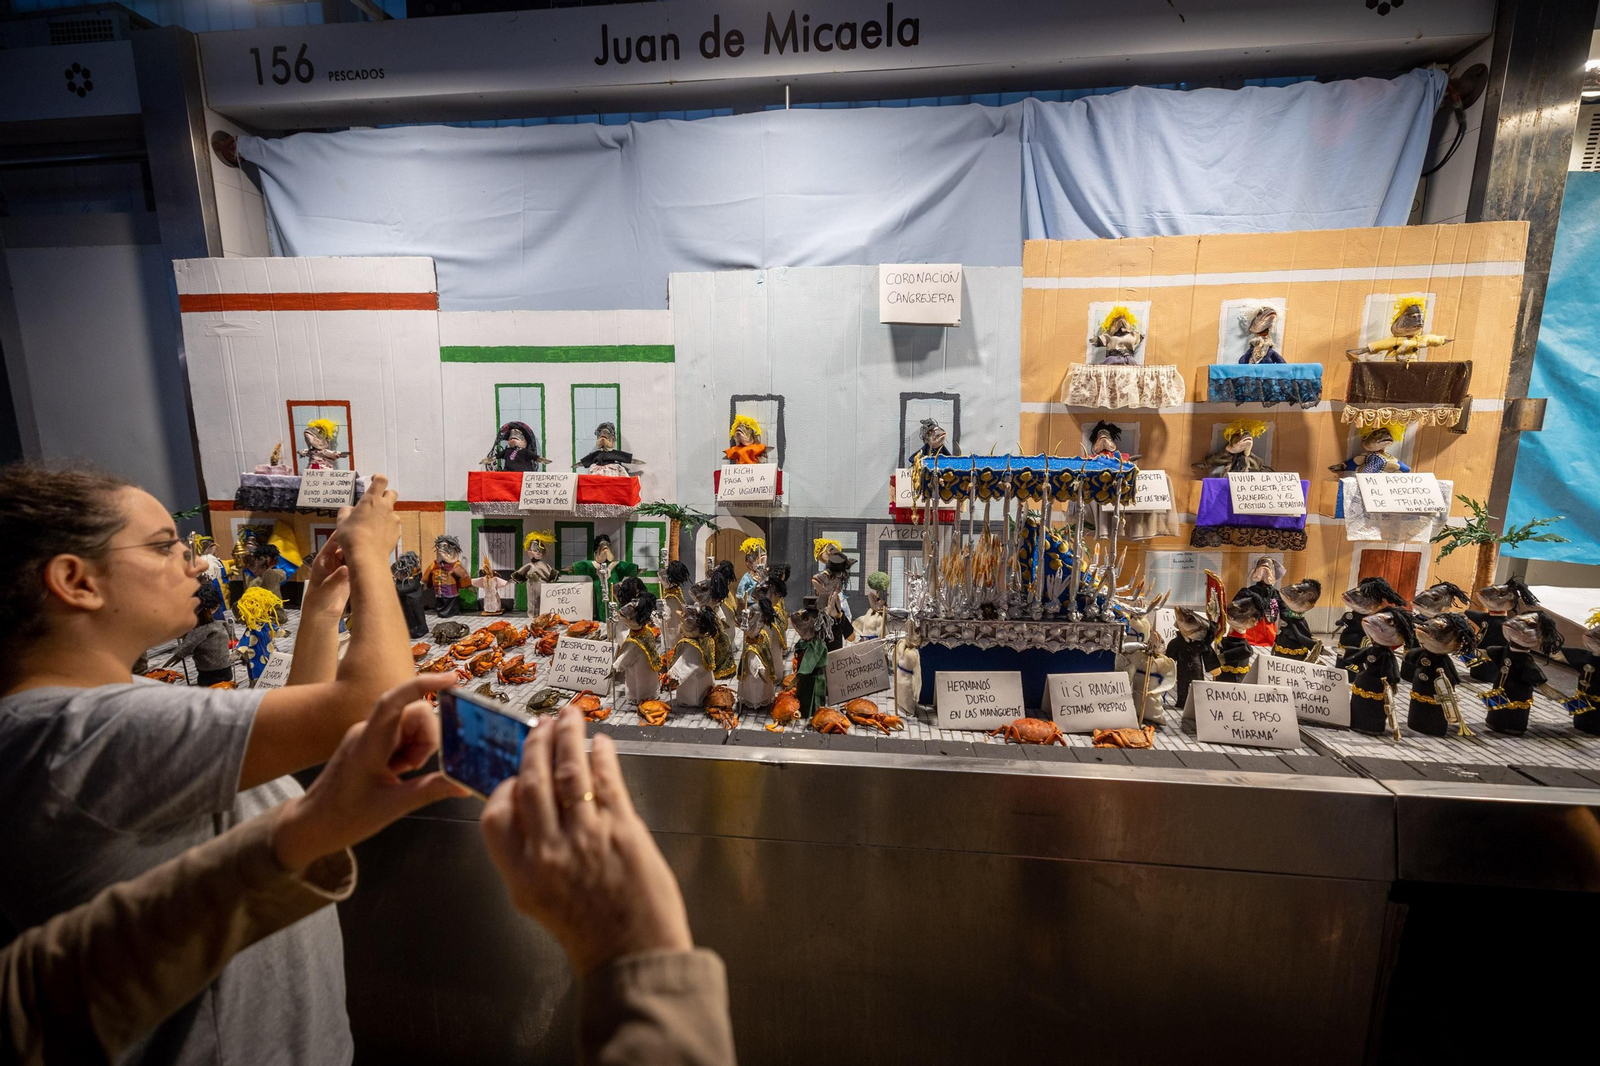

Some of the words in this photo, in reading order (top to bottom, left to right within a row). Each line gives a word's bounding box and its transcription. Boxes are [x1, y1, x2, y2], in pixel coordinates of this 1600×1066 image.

[594, 23, 680, 65] Juan
[700, 14, 744, 59] de
[764, 2, 919, 55] Micaela
[250, 43, 315, 85] 156
[328, 68, 385, 81] PESCADOS
[885, 270, 960, 286] CORONACIÓN
[886, 290, 955, 304] CANGREJERA
[1385, 475, 1423, 484] APOYO
[722, 487, 735, 496] LOS
[1236, 493, 1273, 501] BALNEARIO
[1285, 492, 1295, 500] EL
[1370, 488, 1383, 496] AL
[1389, 487, 1431, 495] MERCADO
[1238, 502, 1266, 510] CASTILLO
[1268, 501, 1275, 509] S.
[1373, 499, 1387, 507] DE
[1394, 498, 1435, 506] TRIANA
[545, 587, 582, 598] COFRADE
[557, 597, 571, 605] DEL
[558, 652, 567, 660] NO
[572, 653, 579, 661] SE
[583, 655, 610, 664] METAN
[555, 663, 566, 672] LOS
[1266, 660, 1307, 675] MELCHOR
[1312, 668, 1343, 682] MATEO
[557, 674, 569, 683] EN
[576, 676, 598, 685] MEDIO
[946, 678, 991, 692] HERMANOS
[1268, 675, 1281, 685] ME
[1286, 678, 1299, 687] HA
[965, 692, 996, 705] DURIO
[1254, 693, 1289, 703] LEVANTA
[949, 710, 961, 719] EN
[964, 708, 978, 718] LAS
[1059, 703, 1095, 716] ESTAMOS
[1097, 702, 1128, 712] PREPAOS
[1209, 708, 1224, 721] YA
[1232, 710, 1245, 722] EL
[1252, 711, 1282, 723] PASO
